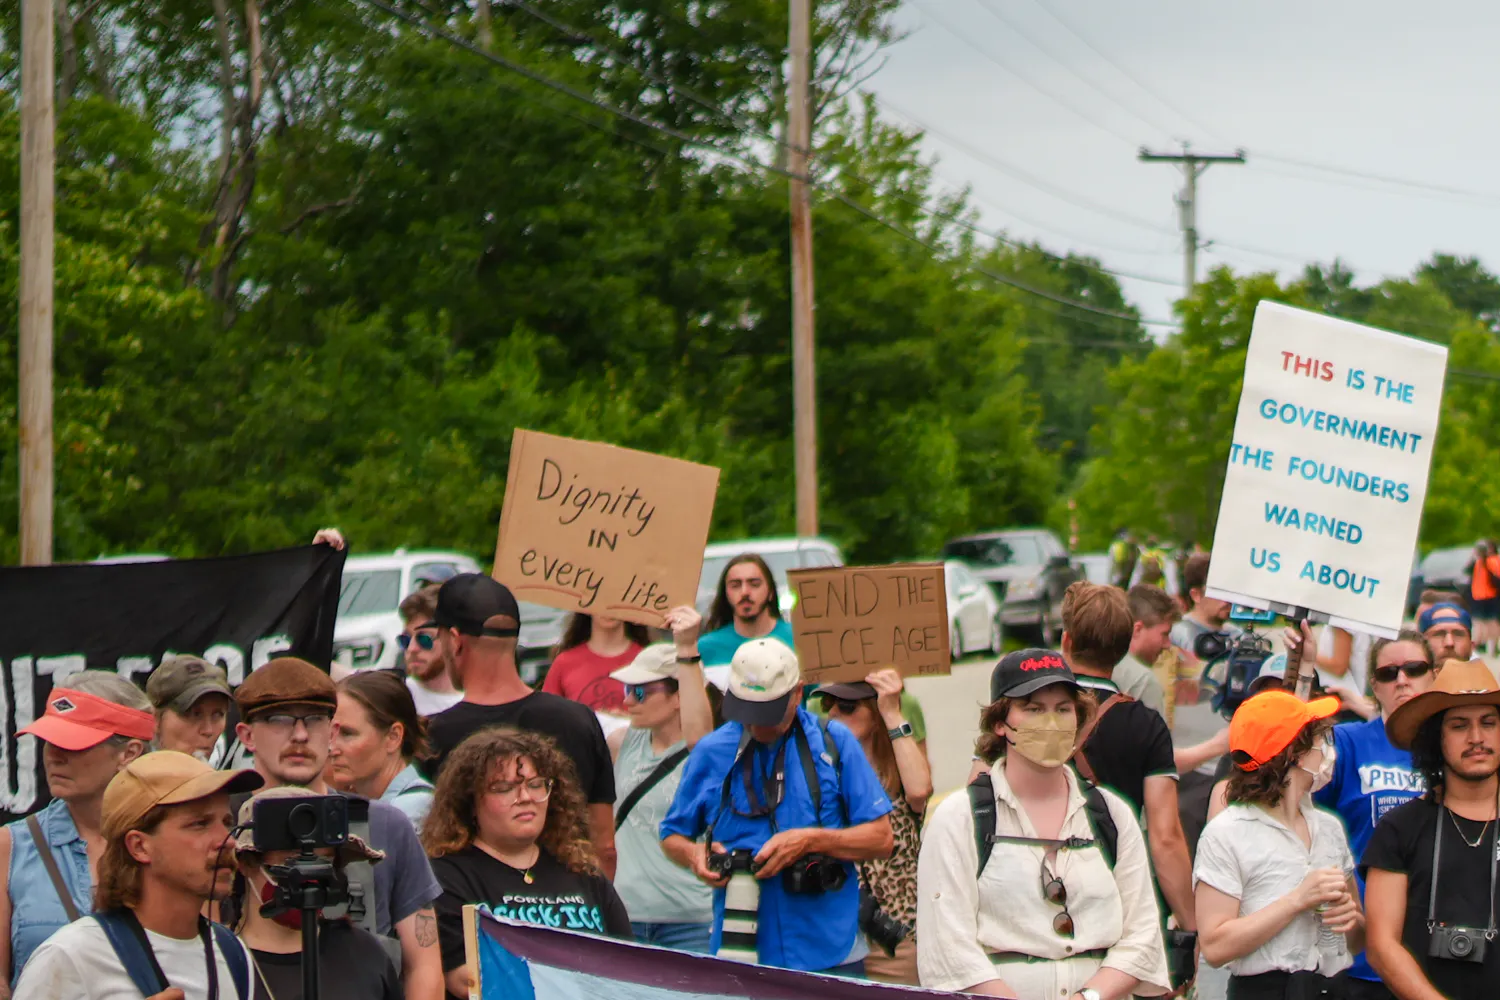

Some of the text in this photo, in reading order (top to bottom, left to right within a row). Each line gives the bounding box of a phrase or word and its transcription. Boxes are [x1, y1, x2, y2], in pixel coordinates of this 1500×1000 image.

[1281, 350, 1415, 404] THIS IS THE
[1259, 398, 1422, 454] GOVERNMENT
[536, 458, 656, 537] Dignity
[1230, 443, 1410, 503] THE FOUNDERS
[587, 529, 619, 552] IN
[1264, 502, 1363, 545] WARNED
[519, 549, 669, 611] every life
[799, 573, 935, 619] END THE
[1249, 547, 1380, 599] US ABOUT
[800, 626, 940, 672] ICE AGE
[502, 895, 585, 905] PORTLAND
